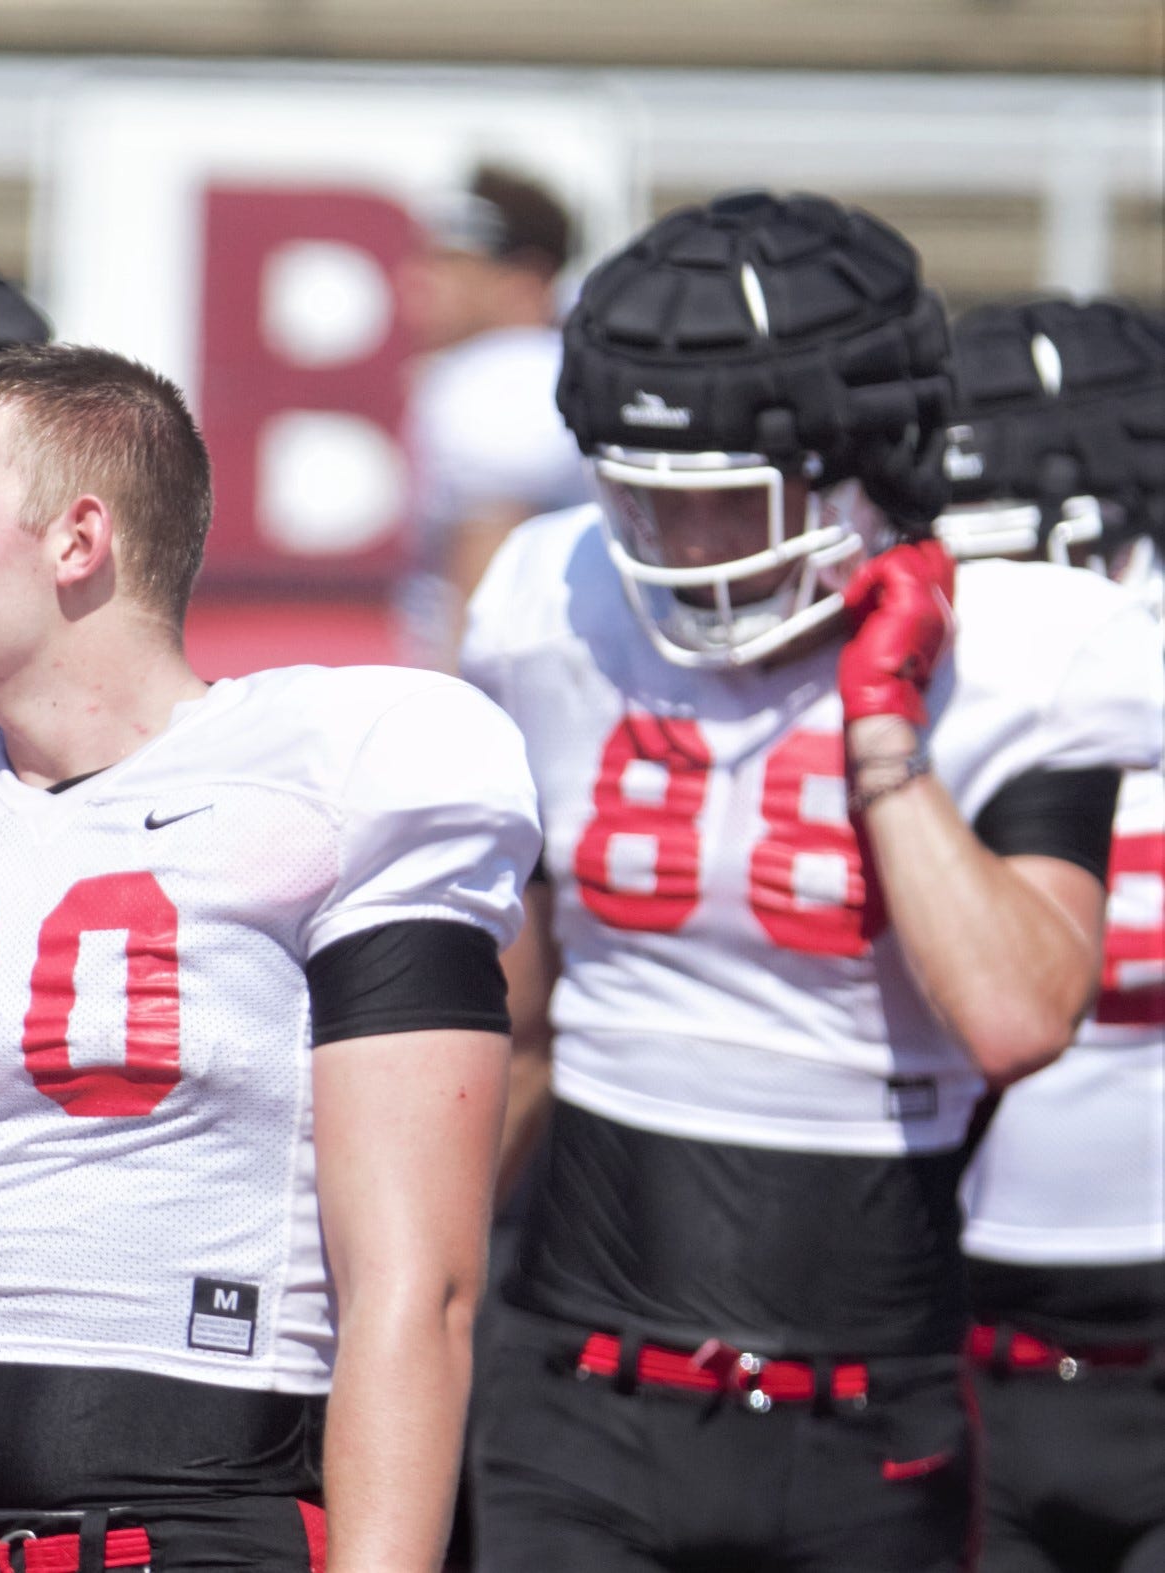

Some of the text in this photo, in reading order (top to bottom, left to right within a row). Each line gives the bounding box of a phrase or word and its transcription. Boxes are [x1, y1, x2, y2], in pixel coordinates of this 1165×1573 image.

[203, 182, 440, 592] B
[574, 712, 872, 958] 88
[214, 1288, 238, 1311] M
